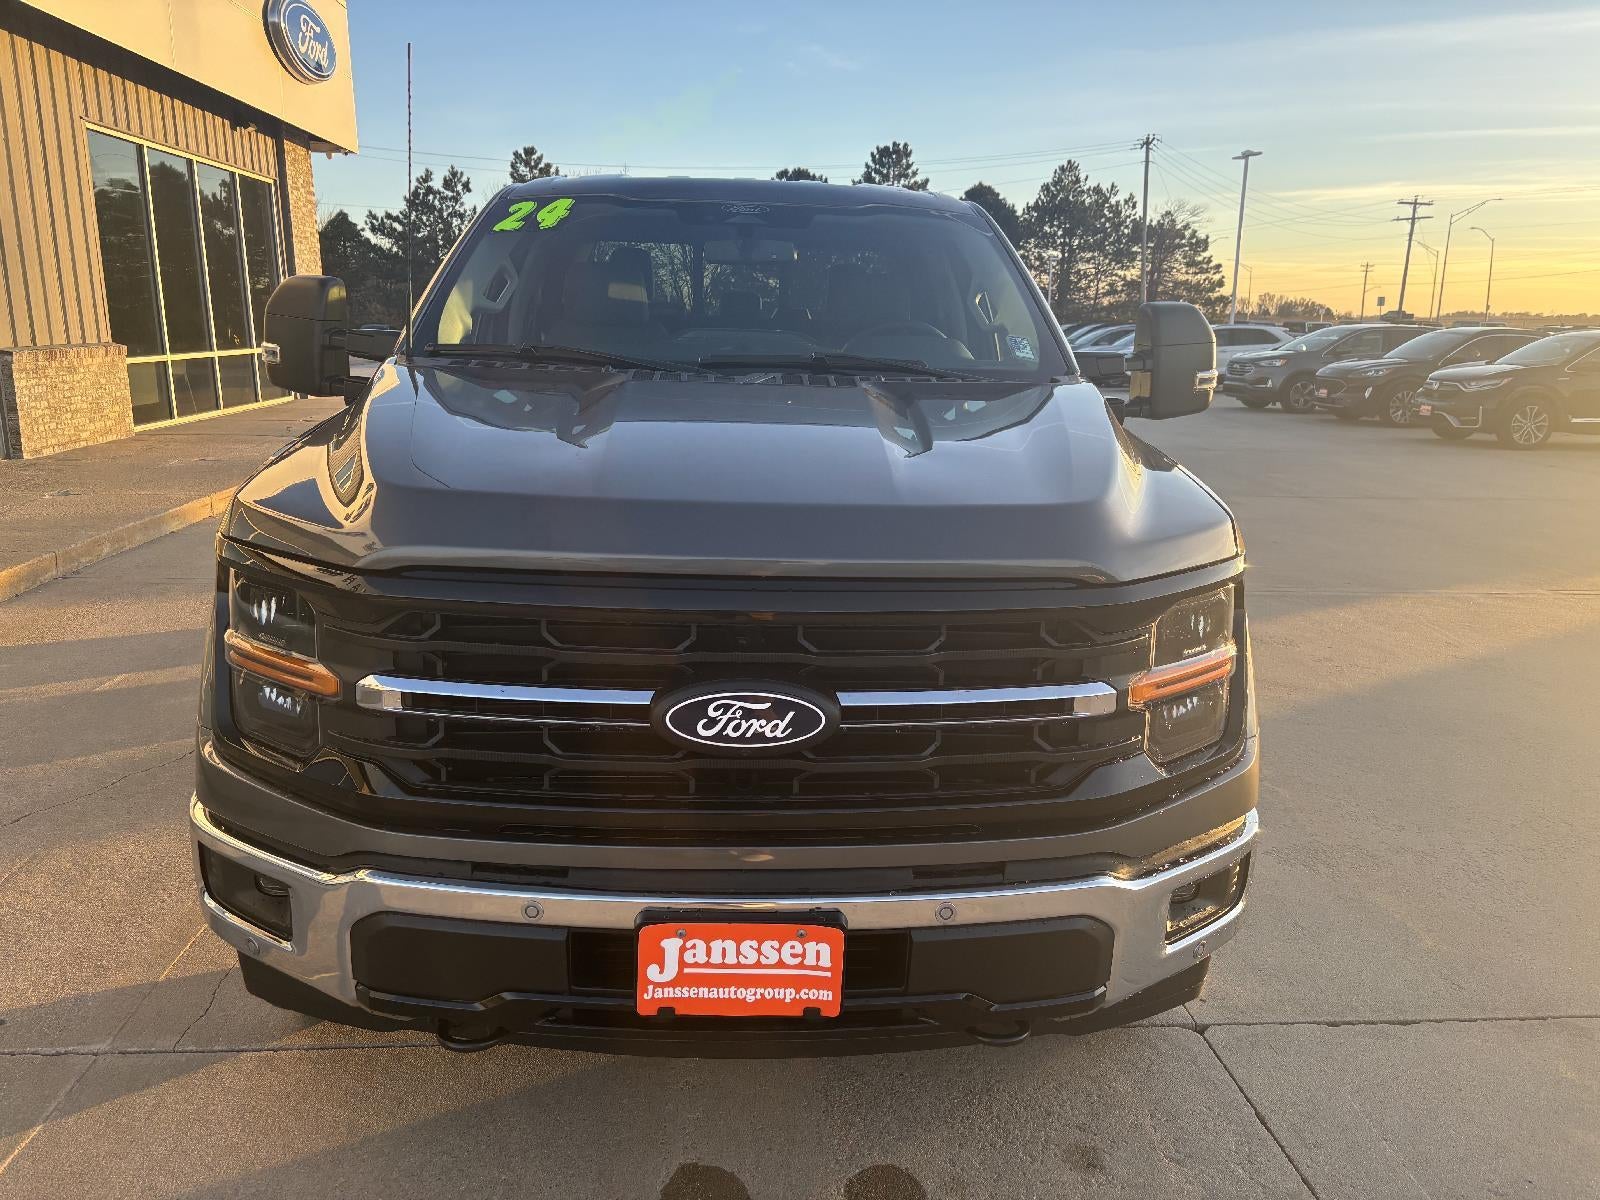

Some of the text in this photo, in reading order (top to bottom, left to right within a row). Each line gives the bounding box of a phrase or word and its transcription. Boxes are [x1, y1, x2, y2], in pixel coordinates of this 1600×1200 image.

[298, 14, 329, 69] Ford
[493, 198, 575, 232] 24
[696, 700, 796, 738] Ford
[646, 937, 832, 982] Janssen
[643, 984, 833, 1002] Janssenautogroup.com
